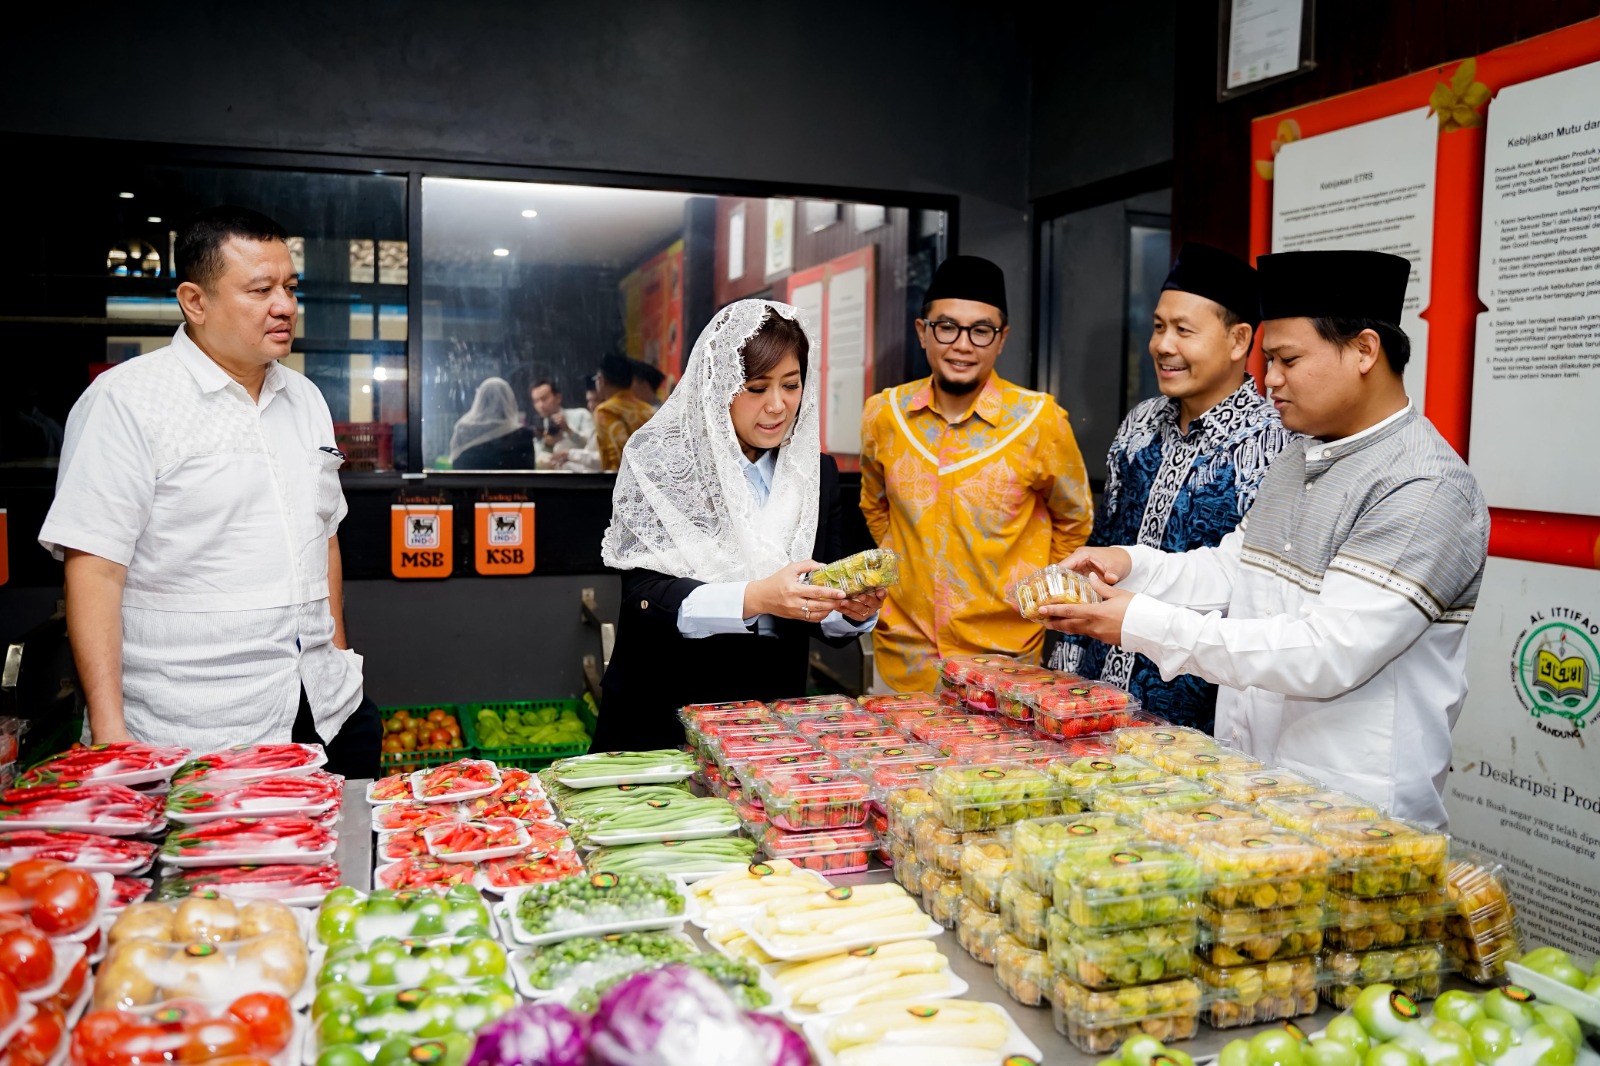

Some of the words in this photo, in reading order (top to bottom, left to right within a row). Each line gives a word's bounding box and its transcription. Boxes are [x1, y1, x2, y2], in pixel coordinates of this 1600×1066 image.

[1508, 132, 1554, 148] Kebijakan
[1557, 125, 1581, 137] Mutu
[1572, 148, 1596, 158] Produk
[401, 552, 444, 568] MSB
[486, 549, 524, 564] KSB
[1530, 612, 1545, 625] AL
[1536, 722, 1581, 739] BANDUNG
[1480, 761, 1557, 800] Deskripsi
[1451, 788, 1474, 803] Sayur
[1477, 796, 1483, 805] &
[1486, 799, 1507, 813] Buah
[1509, 809, 1532, 822] segar
[1534, 818, 1554, 831] yang
[1556, 823, 1577, 839] telah
[1500, 819, 1532, 836] grading
[1534, 829, 1549, 841] dan
[1551, 836, 1596, 860] packaging
[1471, 840, 1477, 848] &
[1479, 843, 1498, 857] Buah
[1537, 868, 1581, 890] merupakan
[1521, 872, 1536, 884] oleh
[1538, 880, 1569, 896] anggota
[1517, 882, 1534, 895] yang
[1536, 889, 1572, 910] diperoses
[1527, 898, 1575, 922] penanganan
[1527, 920, 1546, 933] serta
